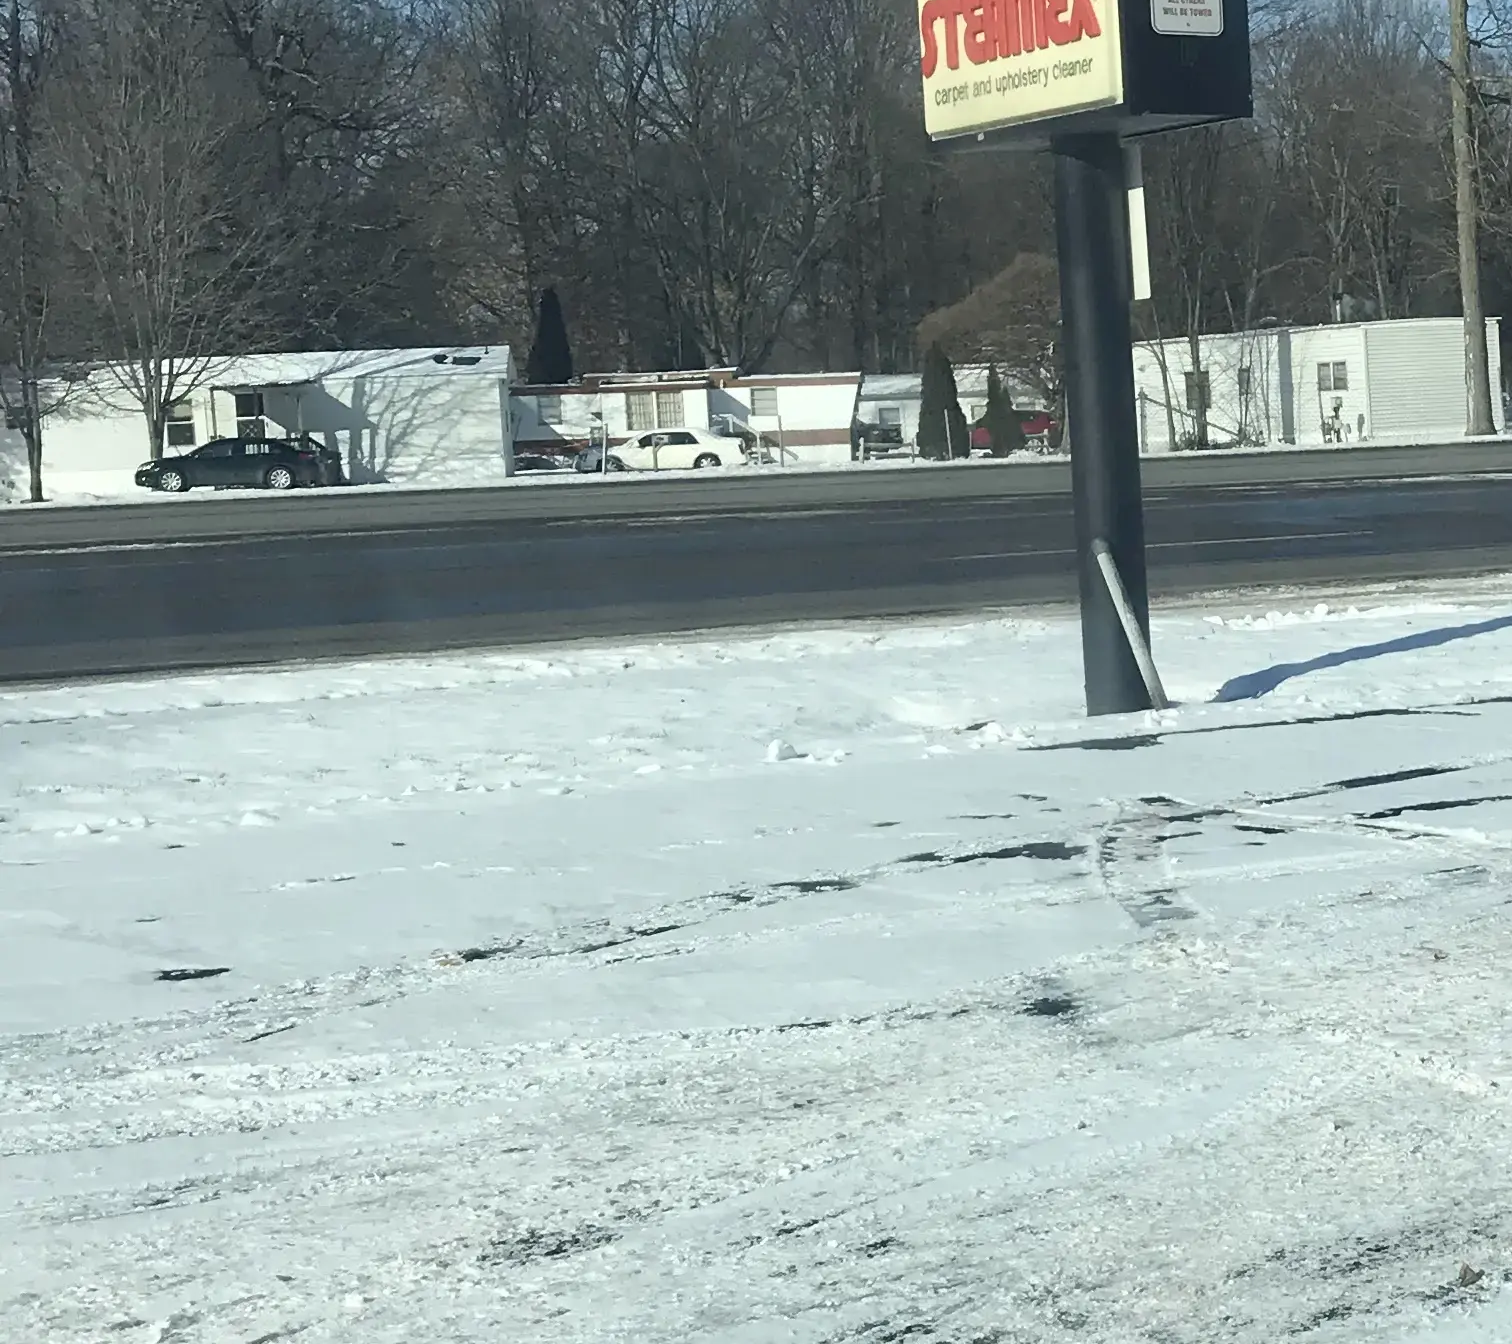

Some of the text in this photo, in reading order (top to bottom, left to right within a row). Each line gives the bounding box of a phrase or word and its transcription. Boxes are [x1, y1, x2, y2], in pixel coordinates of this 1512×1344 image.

[1163, 6, 1212, 17] WILL BE TOWED
[934, 56, 1094, 107] carpet and upholstery cleaner
